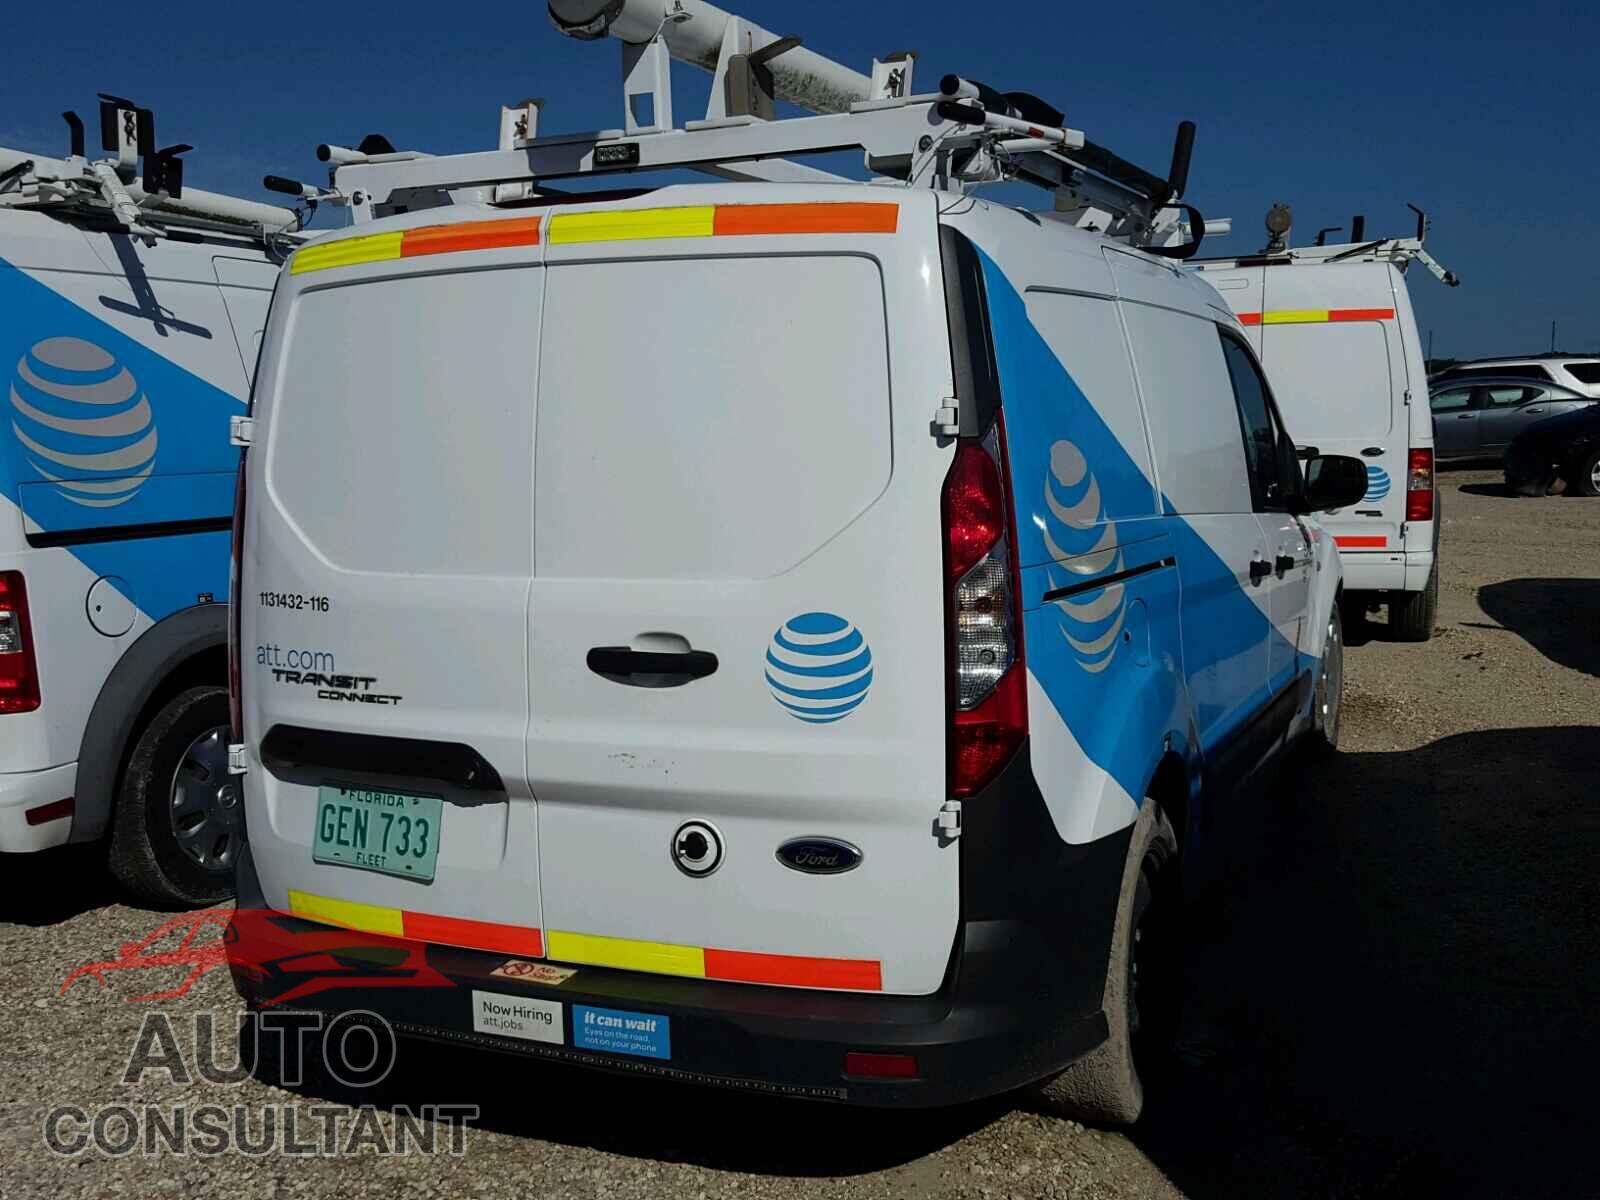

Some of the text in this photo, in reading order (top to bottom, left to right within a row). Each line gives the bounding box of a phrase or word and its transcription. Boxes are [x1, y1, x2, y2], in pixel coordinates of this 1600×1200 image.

[259, 591, 330, 612] 1131432-116
[256, 643, 335, 672] att.com
[271, 668, 377, 690] TRANSIT
[317, 690, 403, 705] CONNECT
[349, 789, 405, 808] FLORIDA
[320, 803, 429, 858] GEN 733
[356, 852, 387, 867] FLEET
[794, 846, 840, 867] Ford
[482, 1001, 553, 1025] Now Hiring
[483, 1016, 524, 1030] att.jobs
[584, 1011, 657, 1033] it can wait
[584, 1026, 603, 1037] Eyes
[615, 1030, 629, 1040] the
[584, 1036, 599, 1045] not
[600, 1039, 611, 1047] on
[611, 1040, 630, 1050] your
